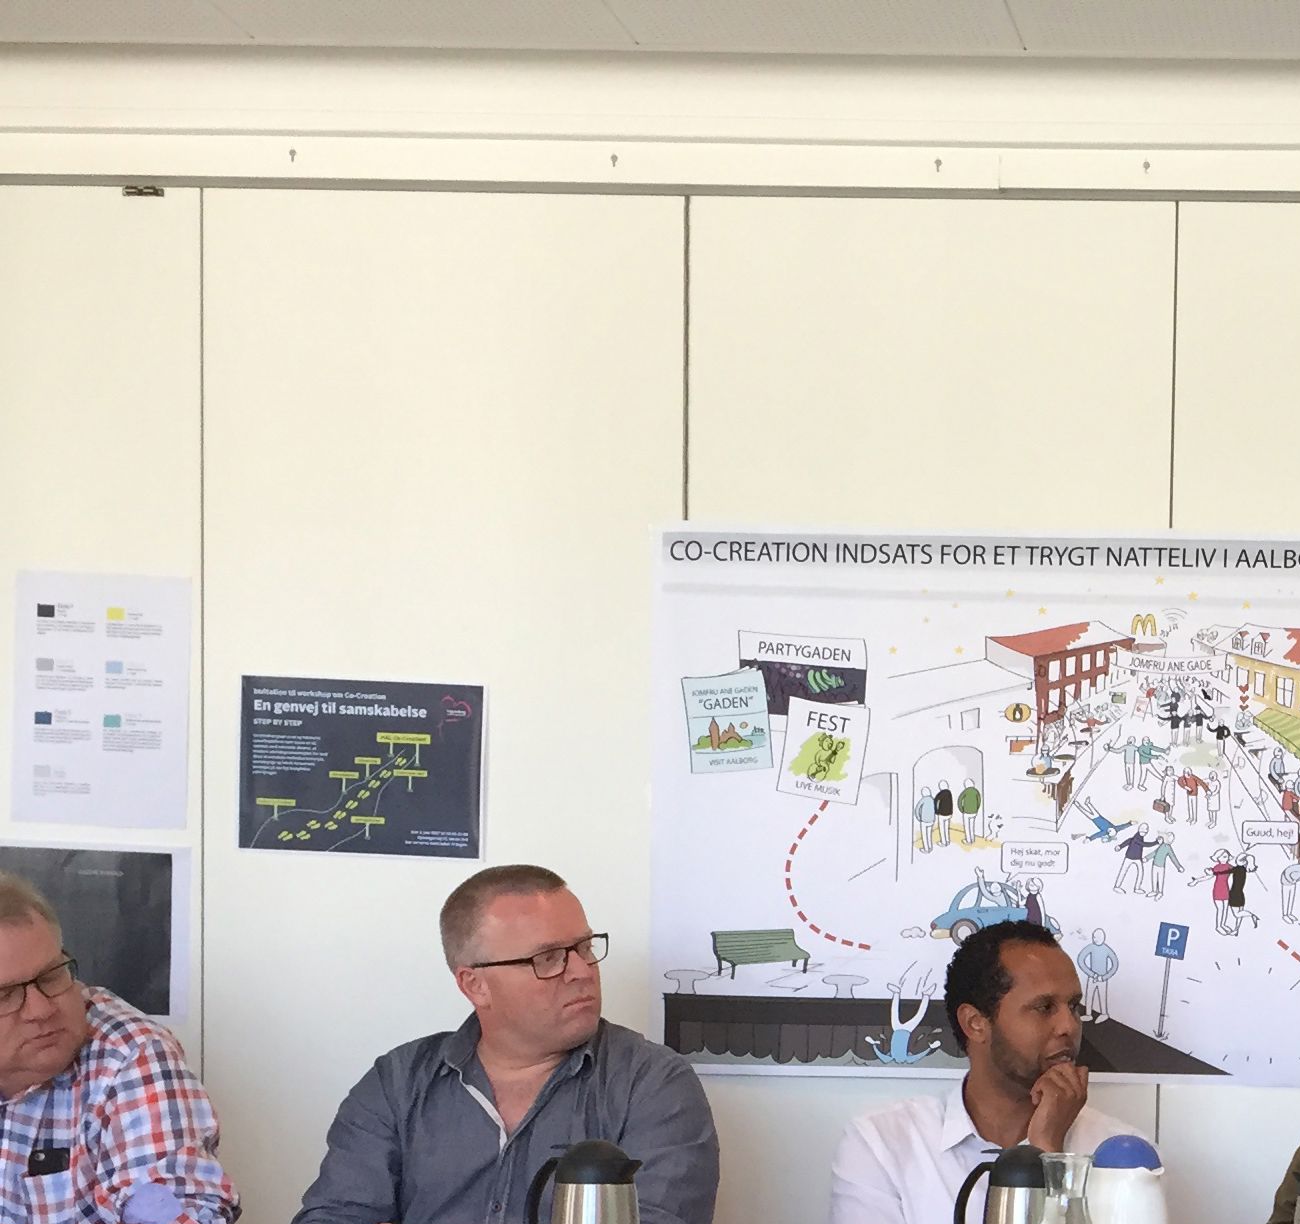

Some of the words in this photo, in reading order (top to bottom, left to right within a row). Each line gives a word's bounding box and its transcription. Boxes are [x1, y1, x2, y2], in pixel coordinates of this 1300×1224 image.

[669, 539, 828, 564] CO-CREATION
[835, 542, 933, 565] INDSATS
[940, 544, 987, 565] FOR
[993, 545, 1022, 566] ET
[1025, 546, 1100, 567] TRYGT
[1106, 546, 1216, 568] NATTELIV
[1222, 548, 1228, 568] I
[757, 640, 852, 662] PARTYGADEN
[1129, 657, 1166, 672] JOMFRU
[1167, 661, 1185, 672] ANE
[1186, 659, 1212, 671] GADE
[253, 699, 271, 711] En
[273, 701, 320, 717] genvej
[321, 701, 337, 714] til
[339, 702, 427, 719] samskabelse
[806, 710, 851, 734] FEST
[795, 780, 813, 791] LIVE
[814, 783, 841, 796] MUSIK
[1166, 928, 1180, 947] P
